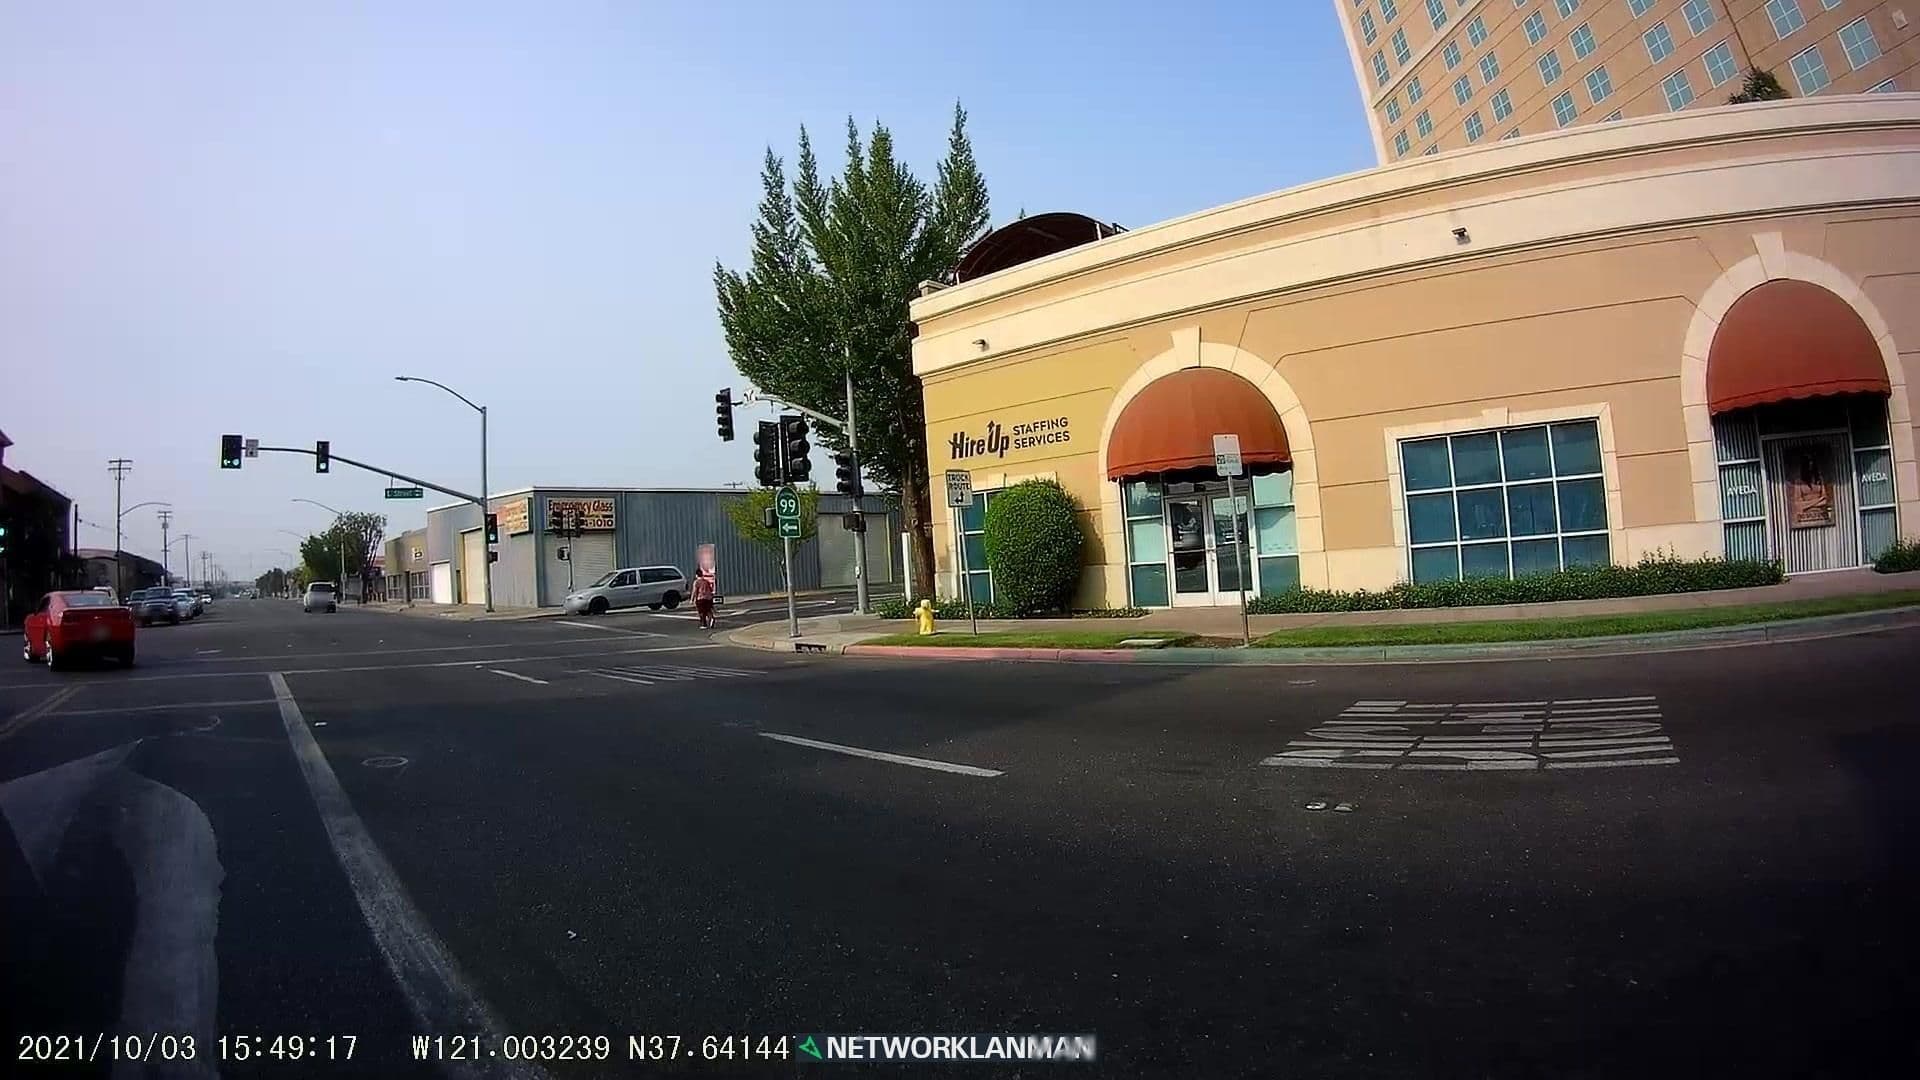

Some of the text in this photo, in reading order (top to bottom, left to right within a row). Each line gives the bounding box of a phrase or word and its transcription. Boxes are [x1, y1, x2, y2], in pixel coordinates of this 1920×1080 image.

[1012, 417, 1069, 436] STAFFING
[948, 420, 1010, 460] Hire Up
[1014, 431, 1071, 450] SERVICES
[948, 473, 969, 482] TRUCK
[949, 482, 971, 491] ROUTE
[592, 499, 614, 512] Glass
[780, 499, 796, 513] 99
